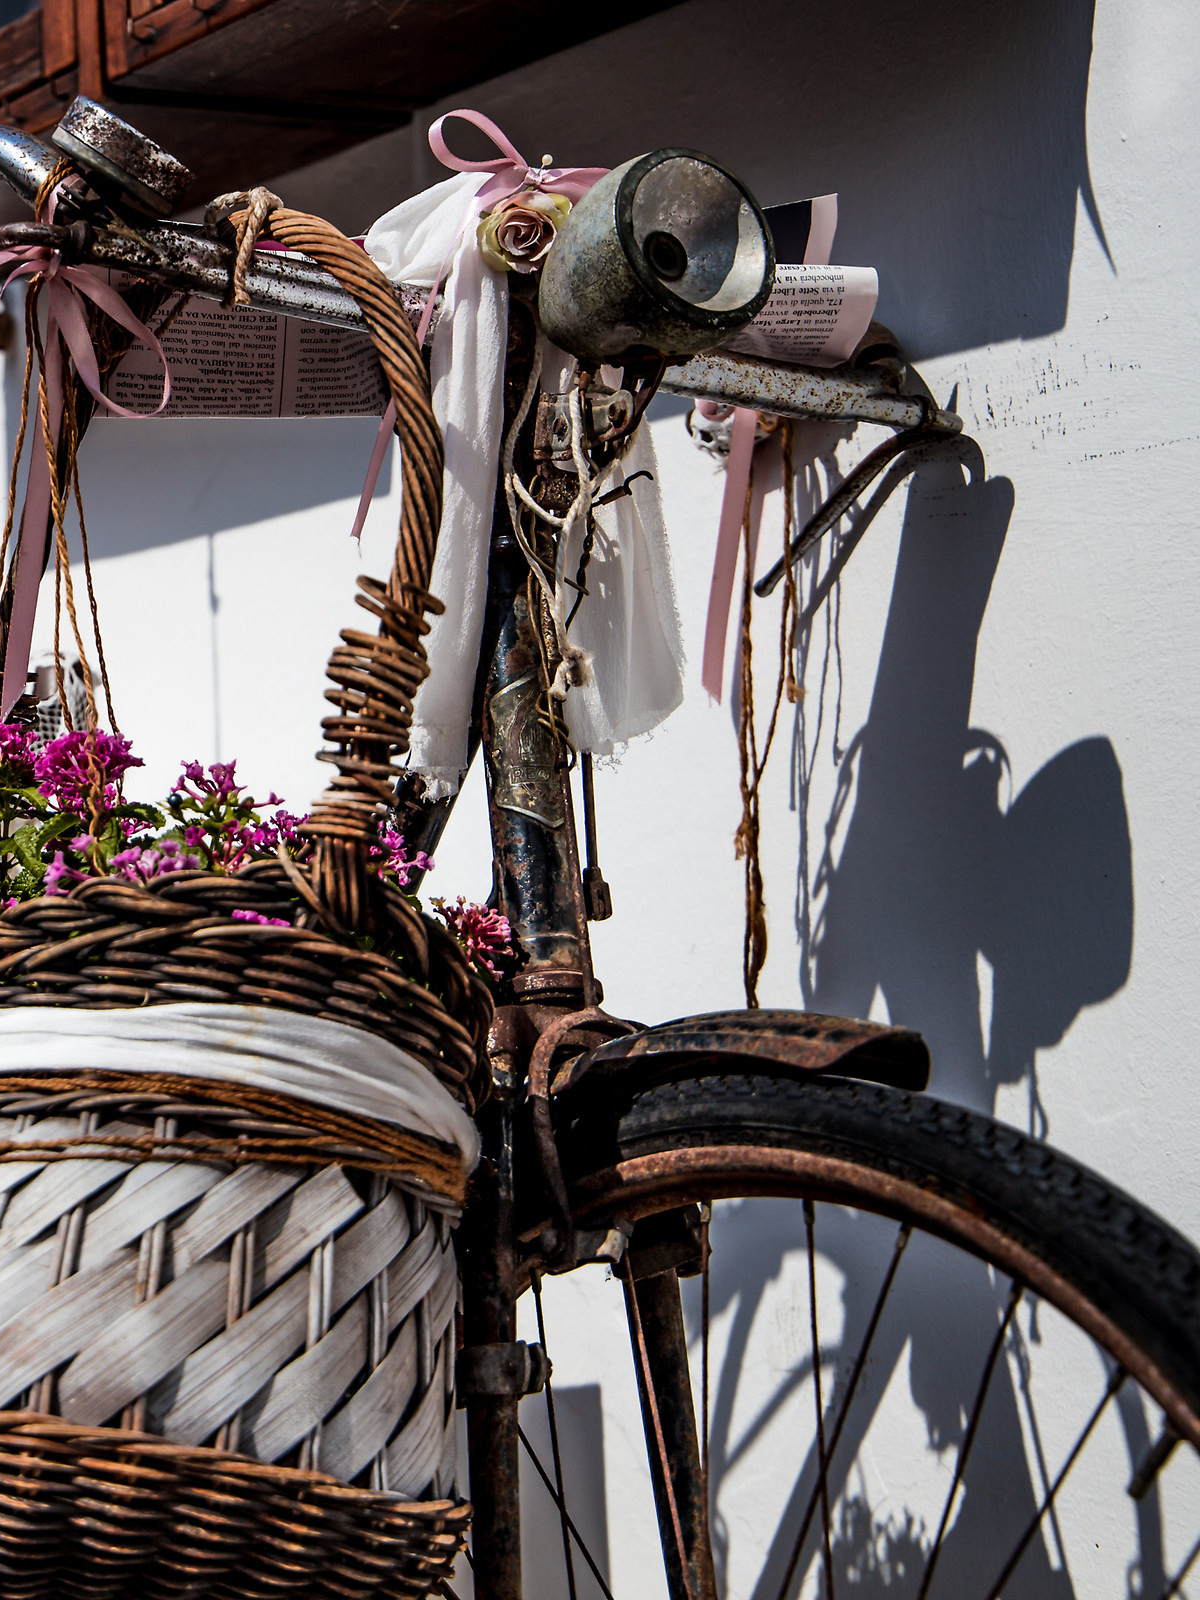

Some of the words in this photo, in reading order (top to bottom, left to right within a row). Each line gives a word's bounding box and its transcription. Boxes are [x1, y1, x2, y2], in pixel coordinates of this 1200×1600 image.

[799, 275, 844, 283] imboccherà
[771, 288, 796, 296] Liber
[798, 287, 819, 295] Sette
[822, 287, 834, 295] via
[800, 297, 824, 306] quella
[202, 313, 236, 321] ARRIVA
[239, 315, 256, 323] CHI
[775, 318, 800, 326] Largo
[229, 324, 263, 332] direzione
[265, 324, 277, 332] per
[191, 330, 234, 339] Notarnicola
[253, 334, 276, 342] Millo,
[199, 359, 235, 367] ARRIVA
[298, 365, 355, 375] valorizzazione
[137, 373, 165, 382] ippolis,
[116, 381, 144, 390] Campo
[334, 397, 370, 407] Direttore
[349, 401, 382, 414] Gazzetta
